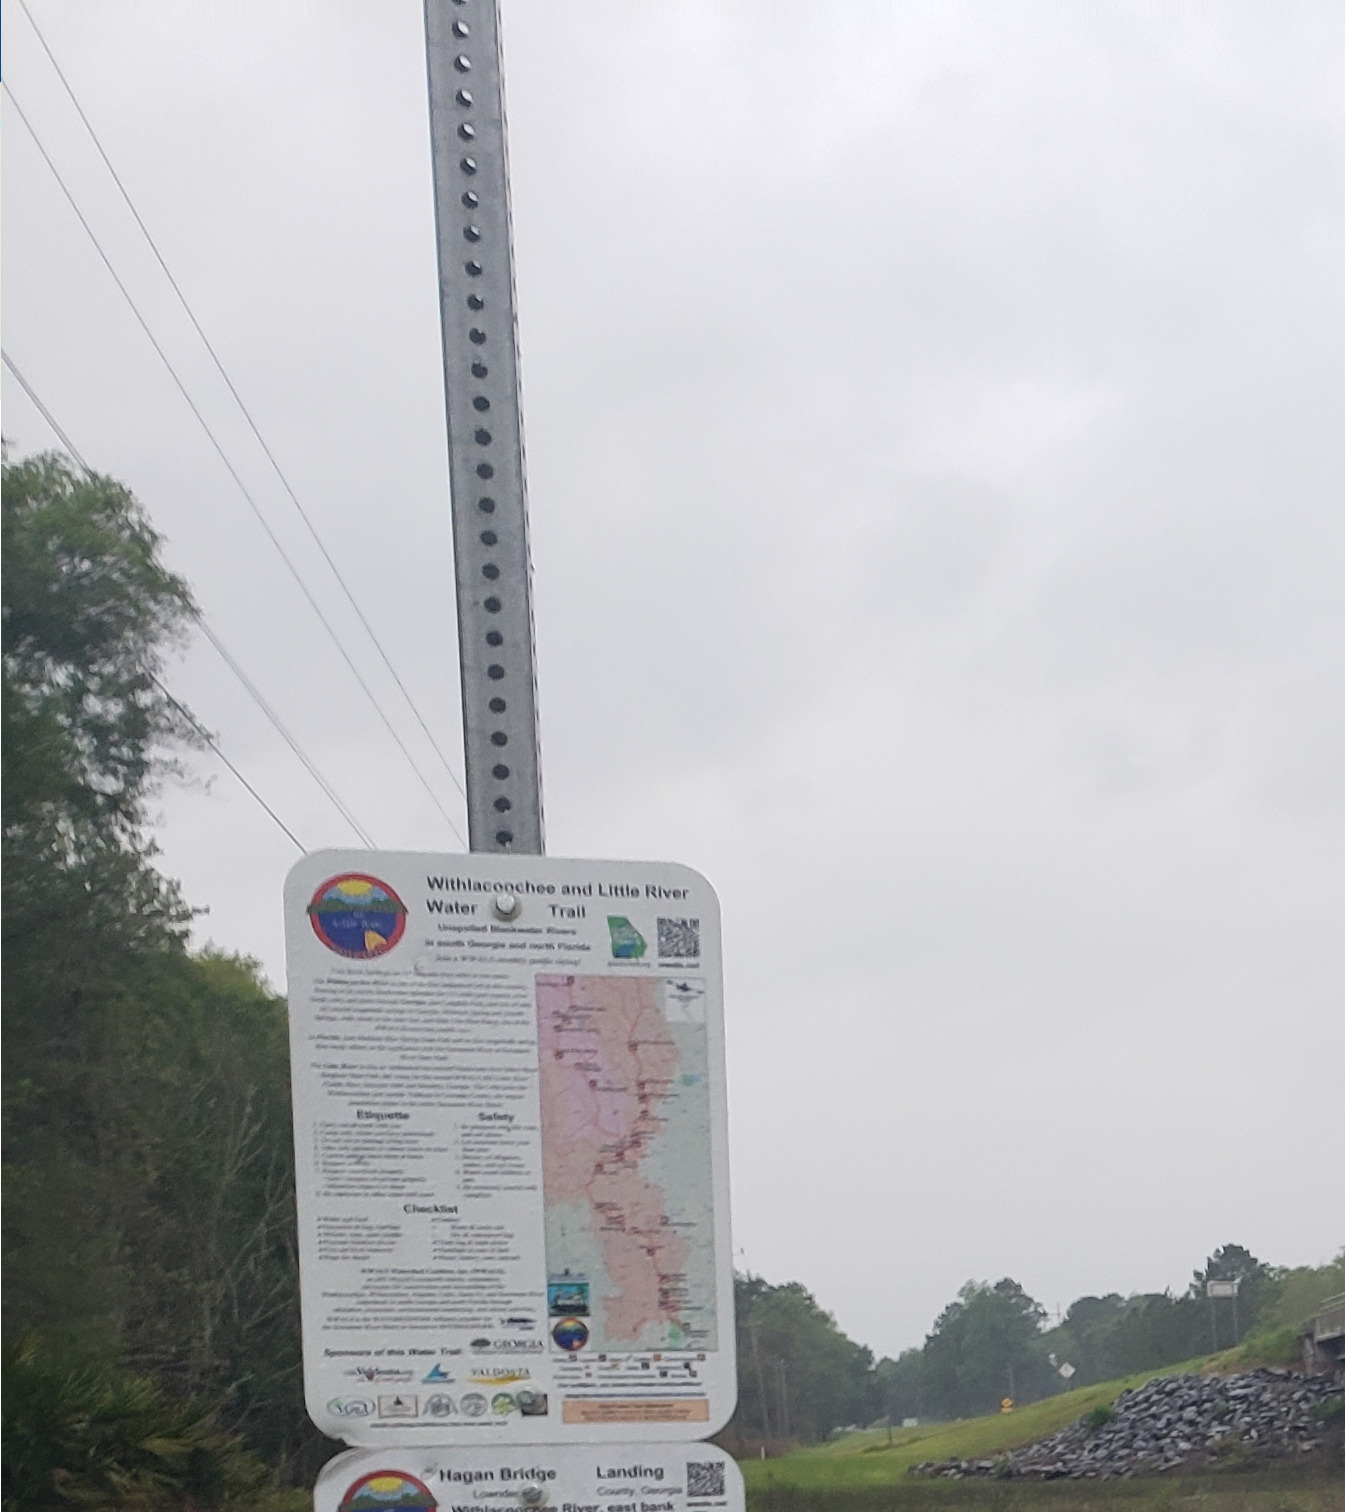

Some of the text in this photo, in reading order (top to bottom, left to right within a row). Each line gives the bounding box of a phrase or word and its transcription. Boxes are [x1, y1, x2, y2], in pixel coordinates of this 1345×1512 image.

[427, 875, 690, 900] Withlacoochee and Little River
[426, 899, 587, 919] Water Trail
[356, 1109, 515, 1124] Etiquette Safety
[403, 1204, 459, 1215] Checklist
[439, 1465, 665, 1486] Hagan Bridge Landing
[640, 1501, 674, 1512] bank
